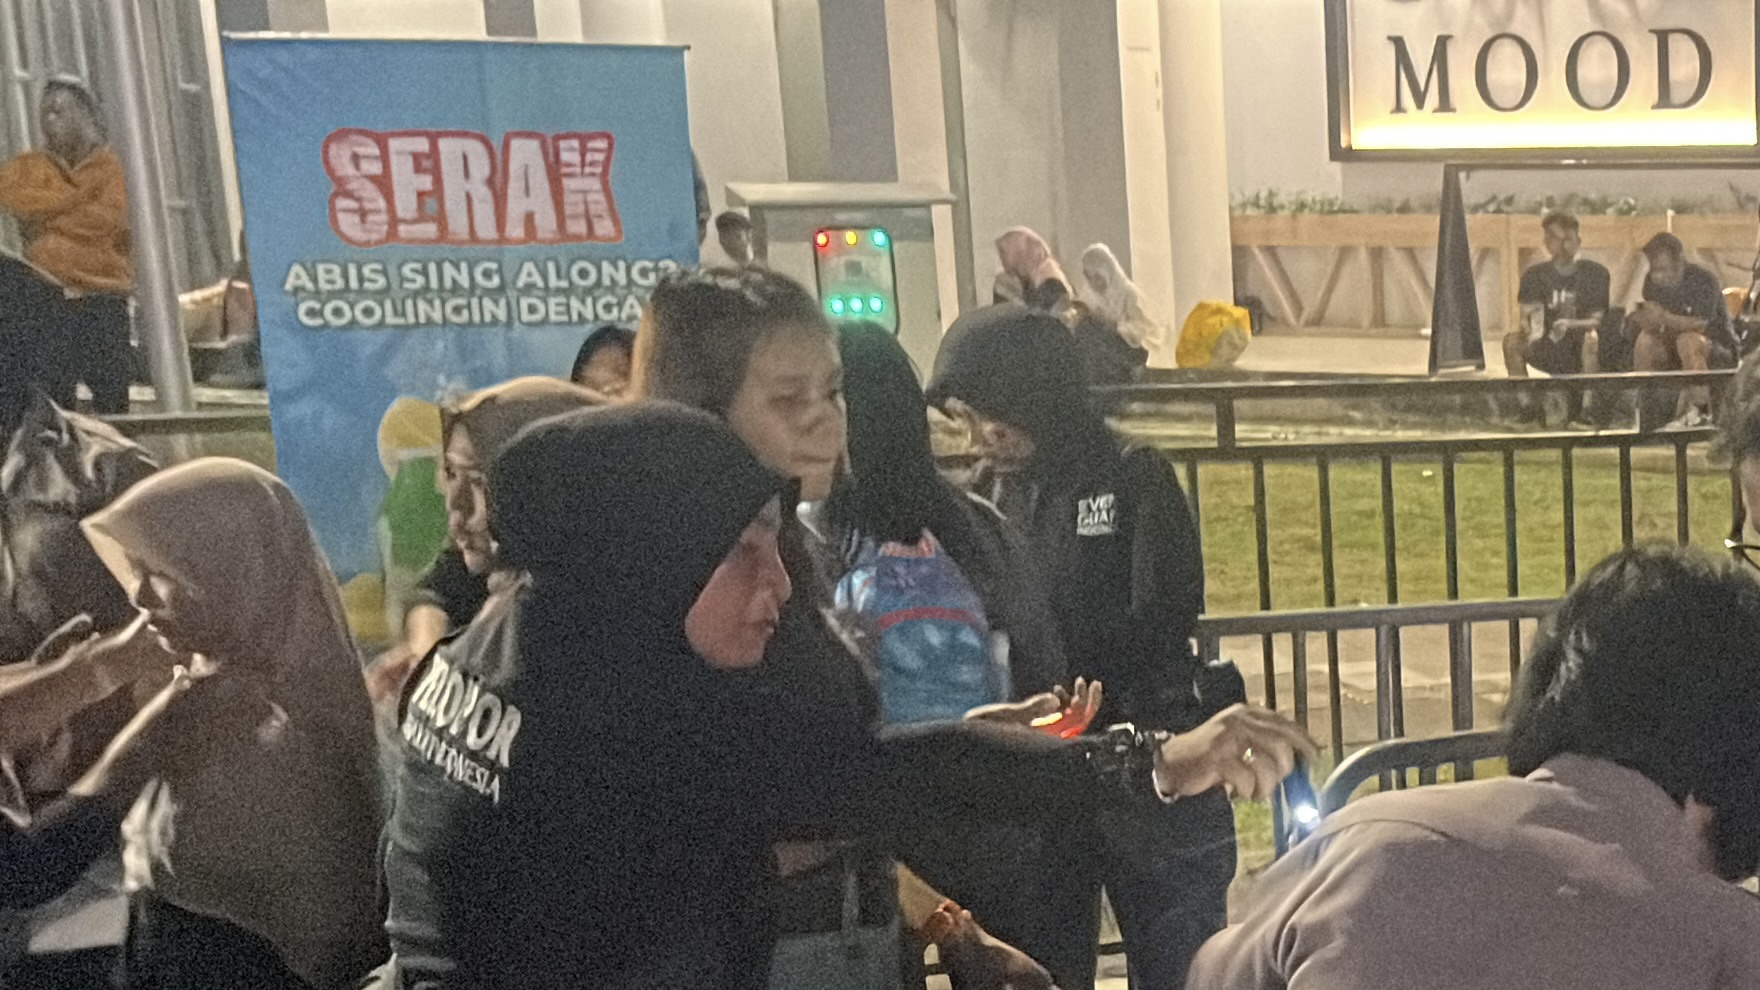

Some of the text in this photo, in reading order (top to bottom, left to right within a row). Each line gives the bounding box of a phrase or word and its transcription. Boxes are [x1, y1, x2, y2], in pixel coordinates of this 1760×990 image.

[1386, 27, 1712, 114] MOOD
[323, 129, 621, 246] SERAK
[284, 261, 387, 291] ABIS
[402, 260, 499, 290] SING
[297, 296, 645, 327] COOLINGIN DENGA
